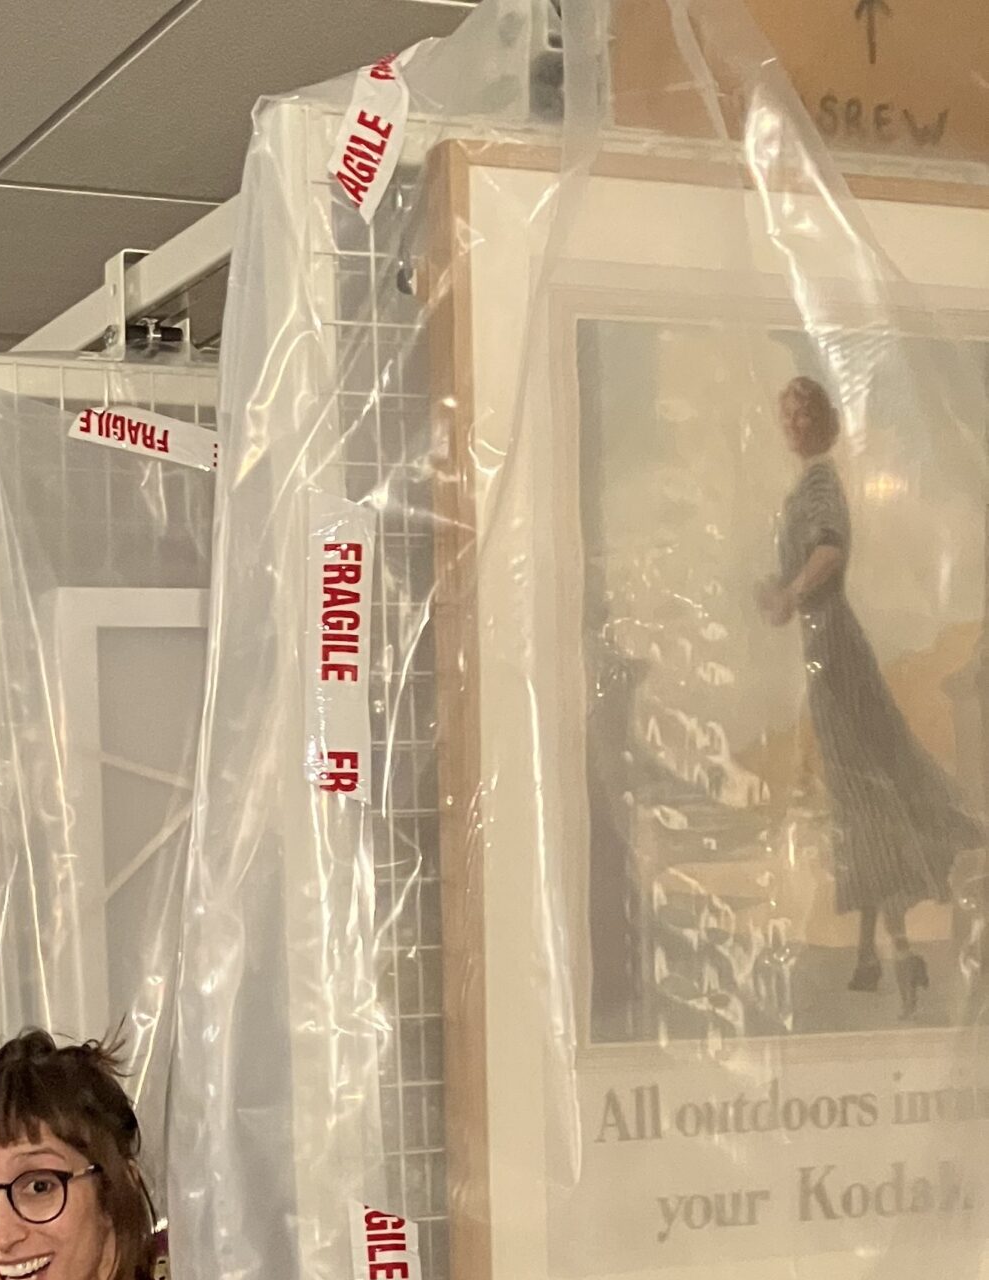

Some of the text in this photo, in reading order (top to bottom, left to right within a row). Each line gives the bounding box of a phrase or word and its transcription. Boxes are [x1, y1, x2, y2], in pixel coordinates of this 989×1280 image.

[79, 408, 170, 453] FRAGILE
[321, 542, 363, 682] FRAGILE
[594, 1084, 662, 1143] All
[675, 1078, 879, 1138] outdoors
[657, 1189, 770, 1243] your
